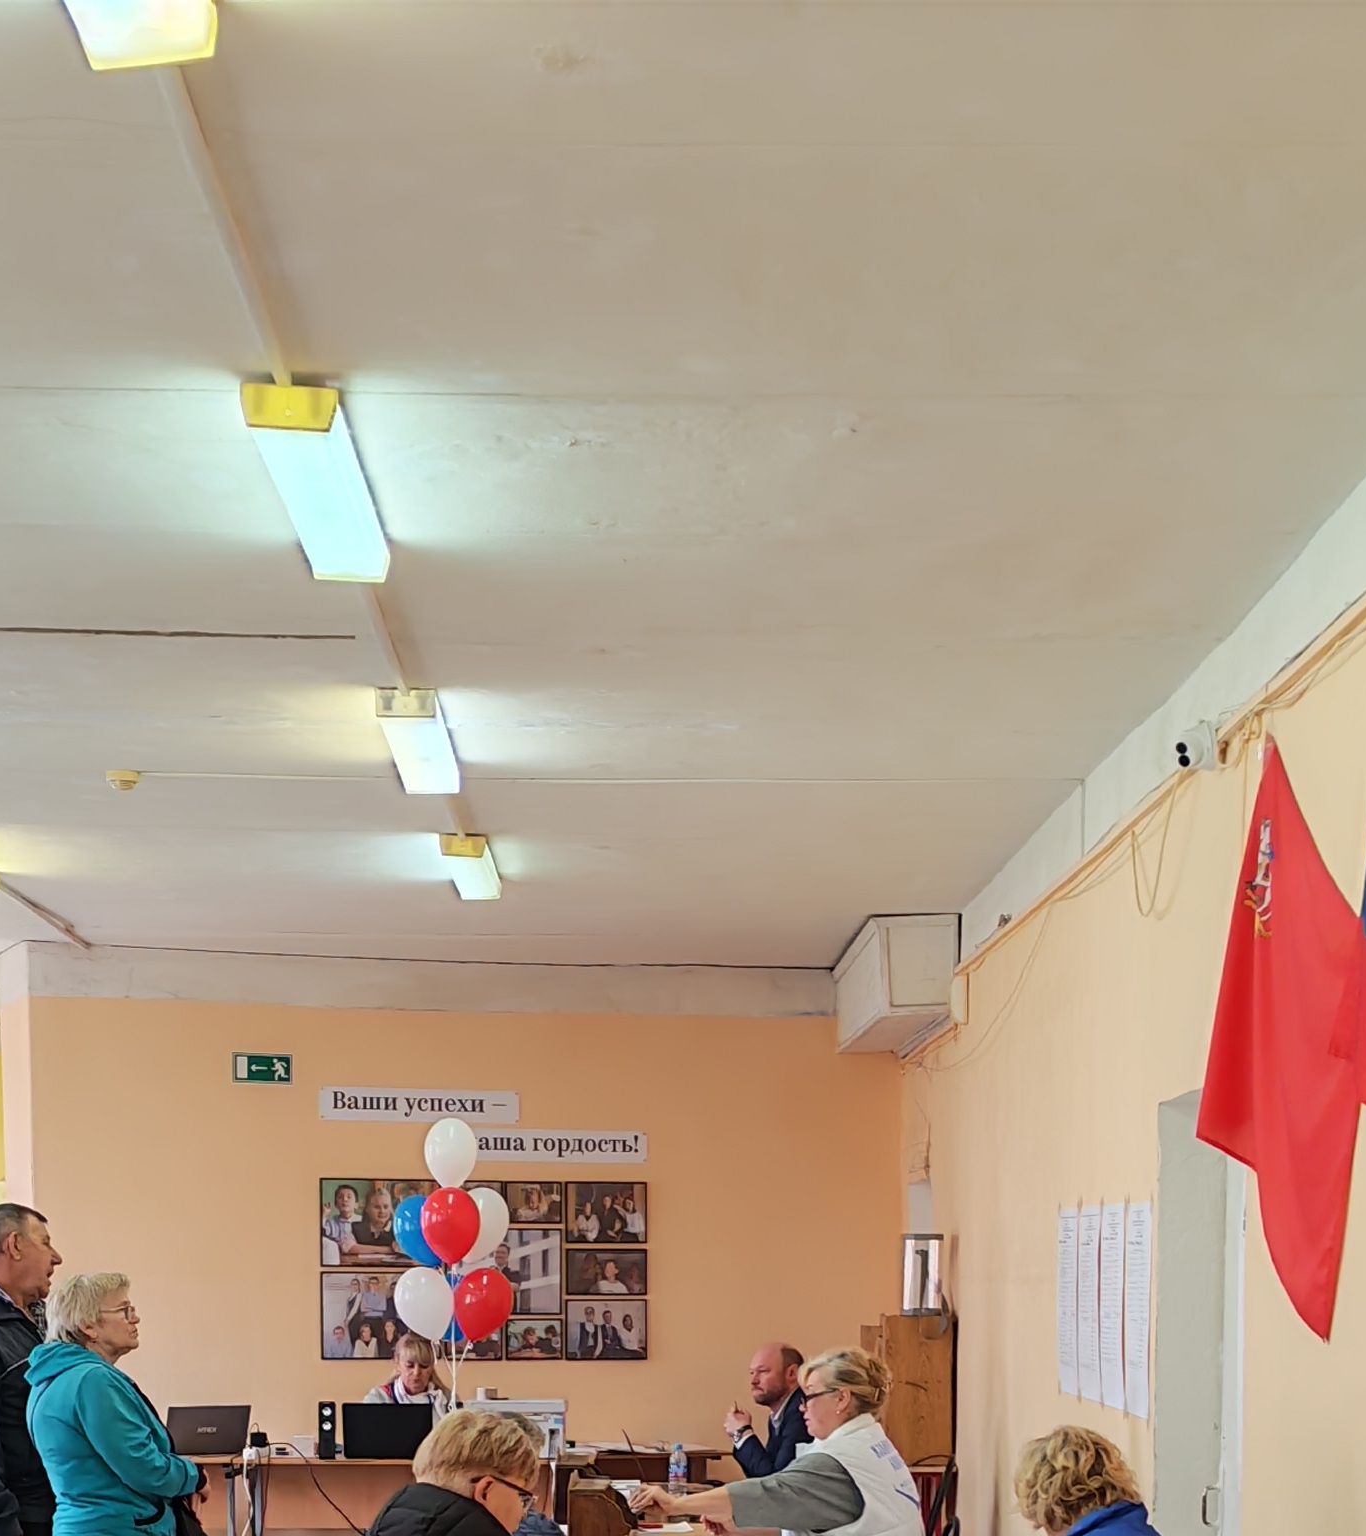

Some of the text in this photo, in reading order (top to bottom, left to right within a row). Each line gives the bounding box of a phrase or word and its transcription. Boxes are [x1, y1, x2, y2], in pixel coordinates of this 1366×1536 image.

[332, 1091, 398, 1111] Ваши
[404, 1096, 485, 1117] успехи
[475, 1134, 640, 1157] аша гордость!
